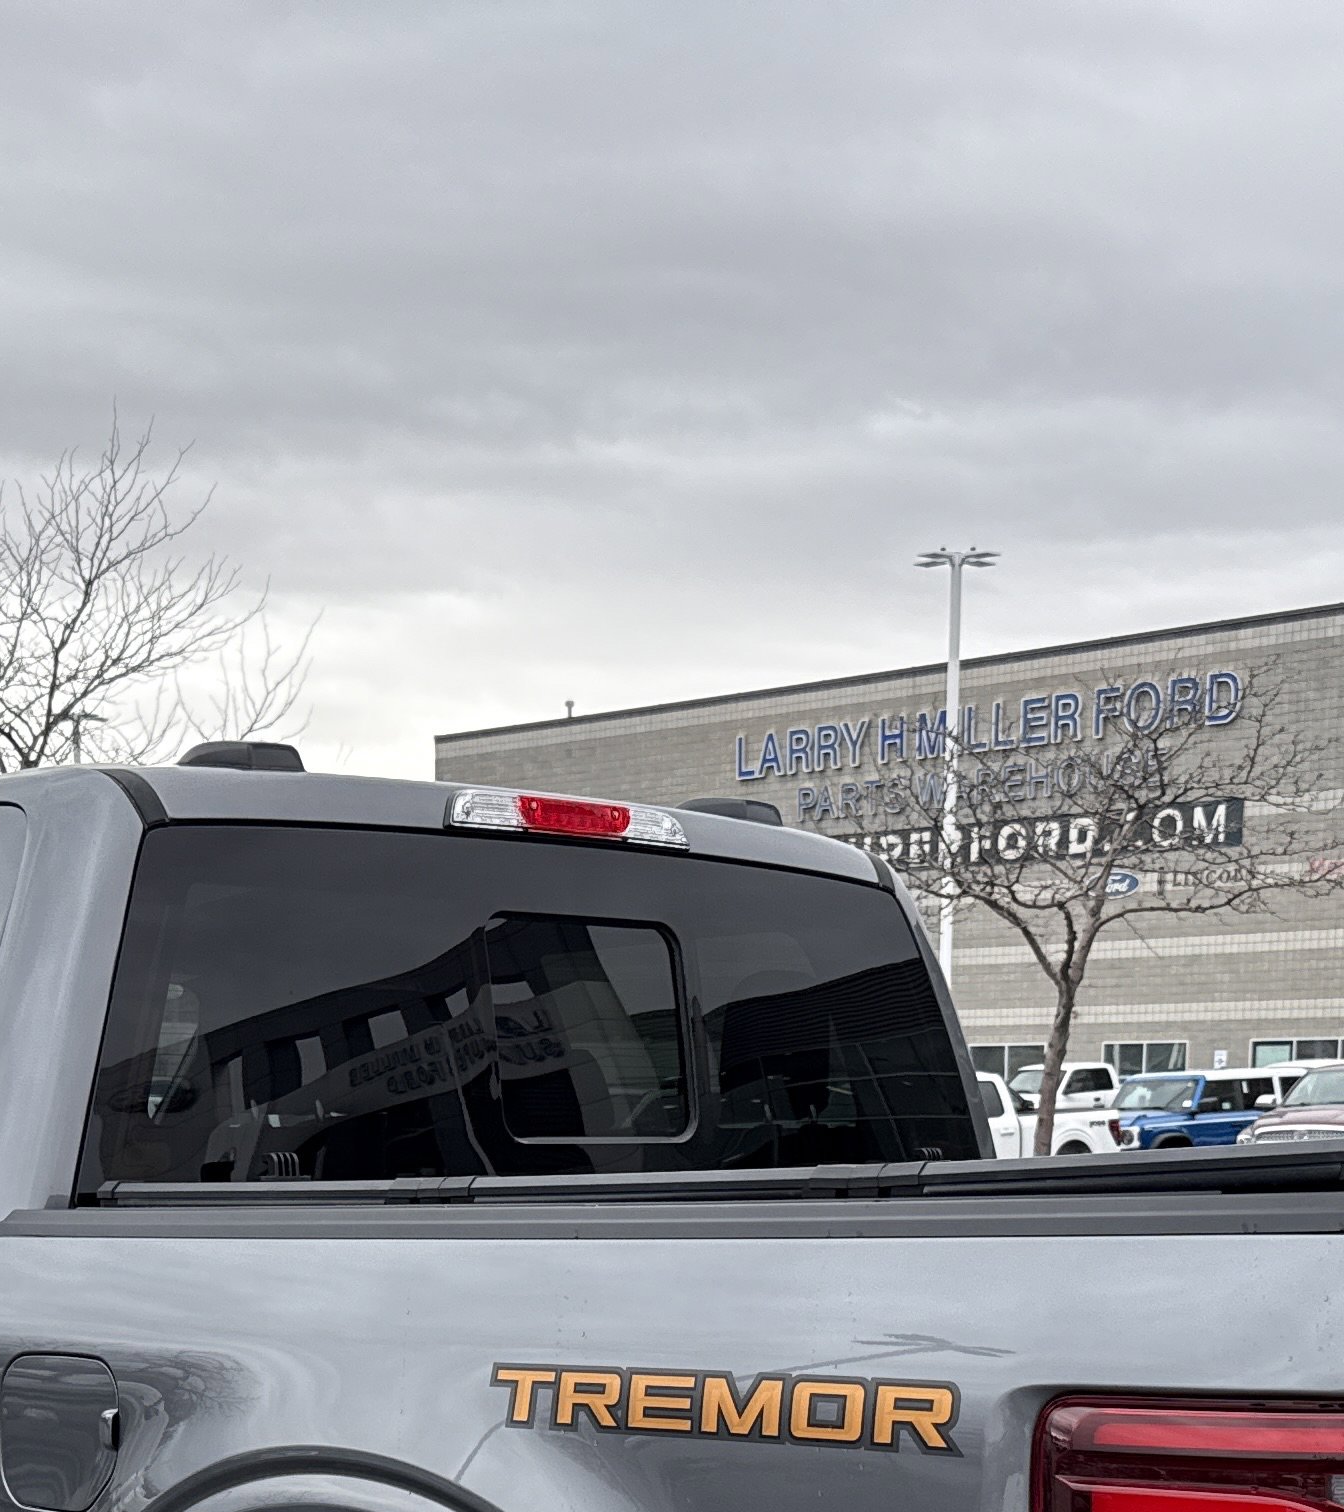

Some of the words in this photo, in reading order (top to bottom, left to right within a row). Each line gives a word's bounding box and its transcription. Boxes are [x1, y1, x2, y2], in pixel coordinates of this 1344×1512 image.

[736, 719, 870, 781] LARRY
[878, 712, 906, 764] H
[915, 692, 1082, 760] MLLER
[1092, 671, 1244, 740] FORD
[797, 777, 905, 822] PARTS
[917, 746, 1168, 809] WREHOUE
[491, 1362, 963, 1457] TREMOR
